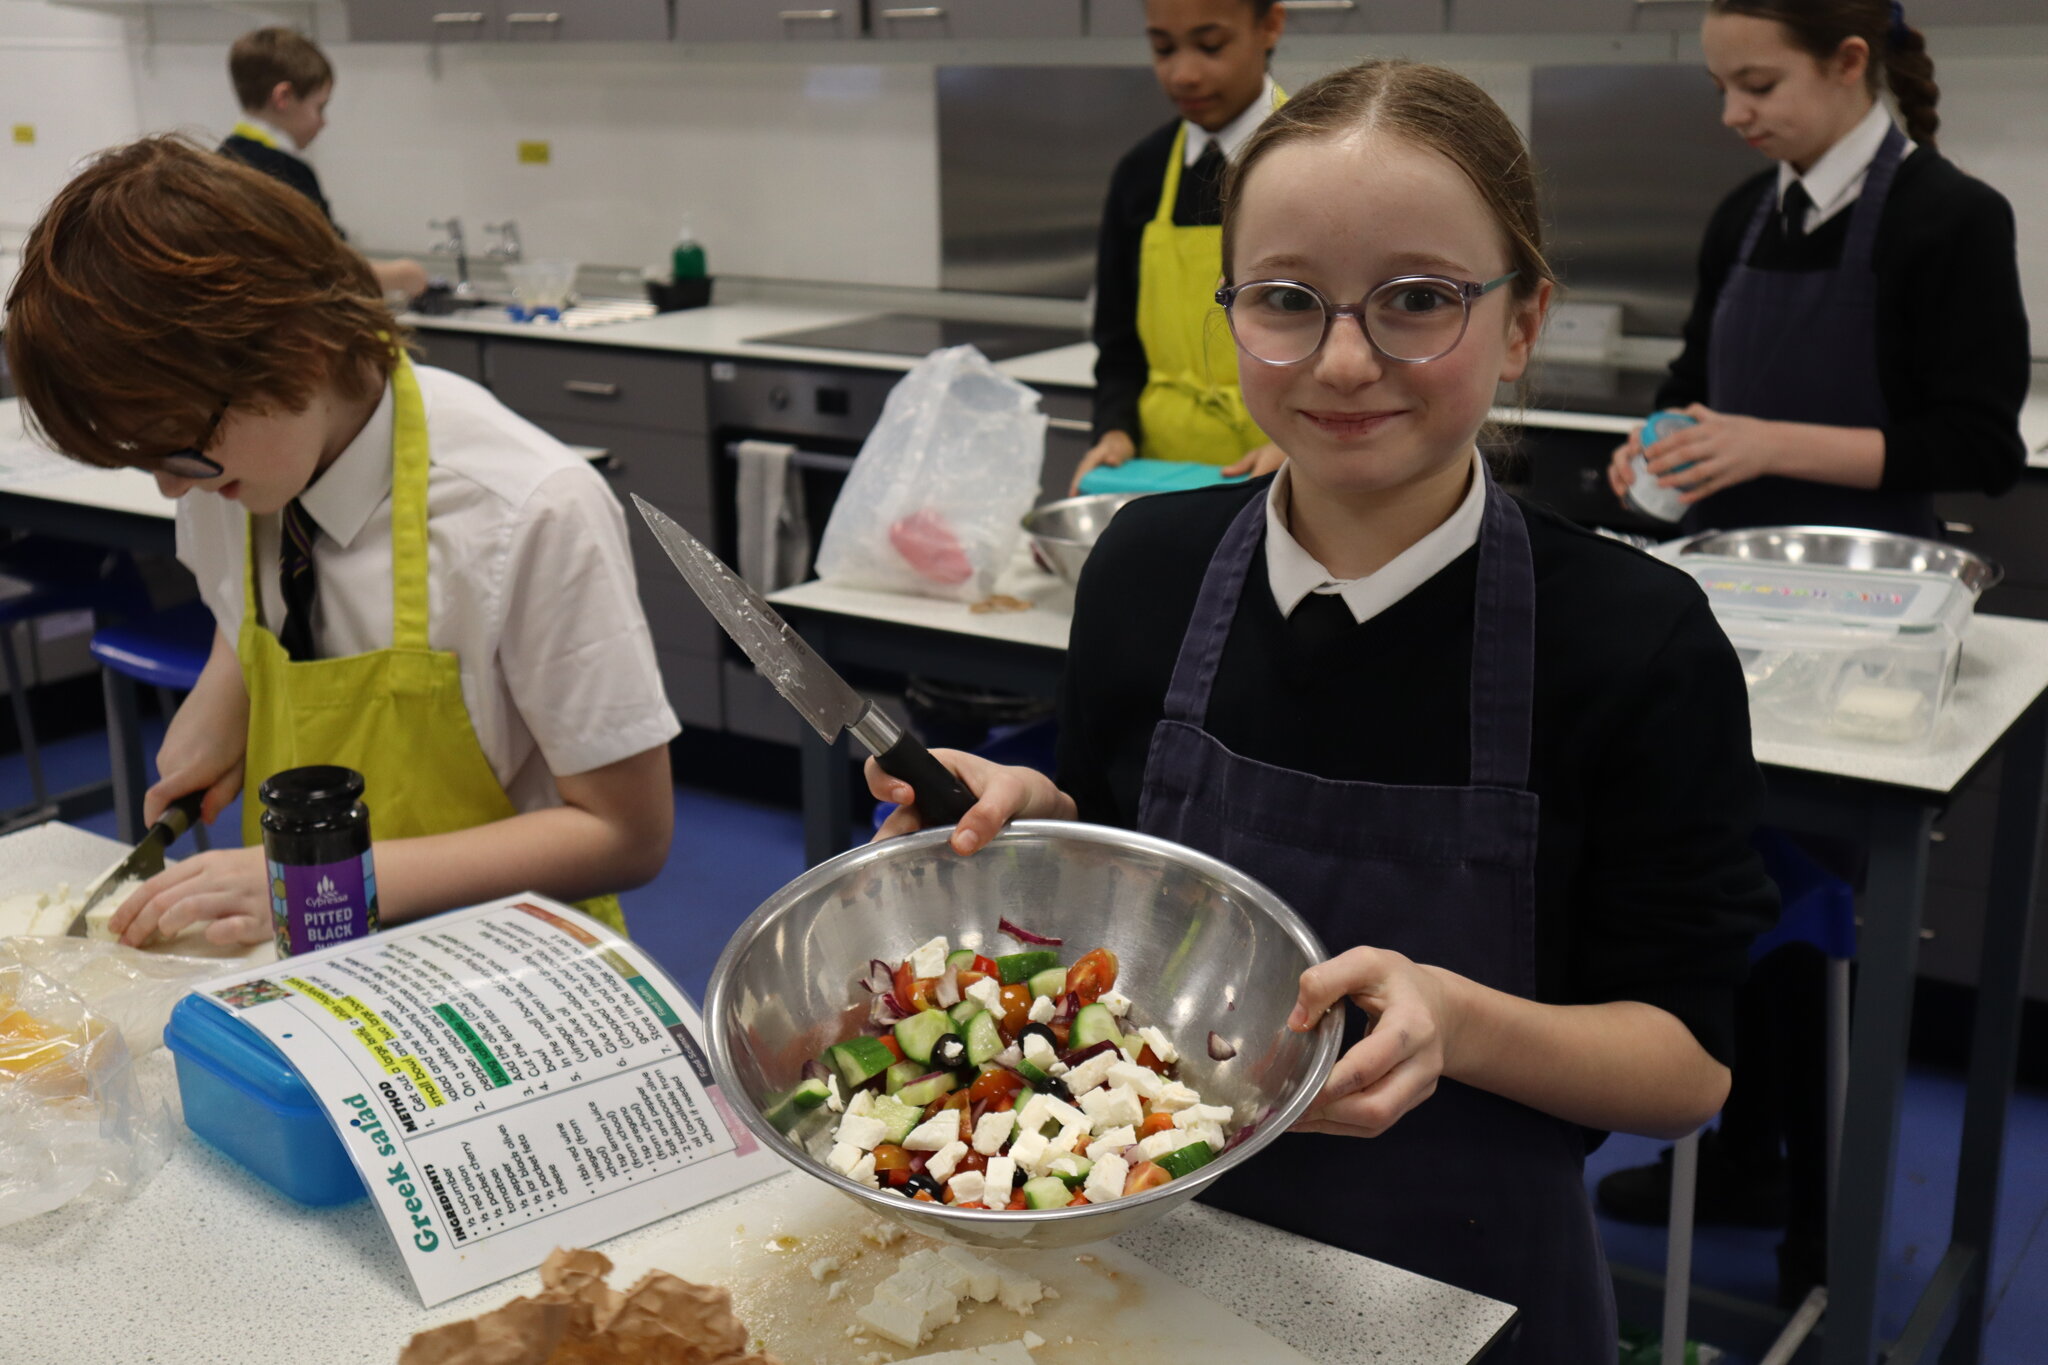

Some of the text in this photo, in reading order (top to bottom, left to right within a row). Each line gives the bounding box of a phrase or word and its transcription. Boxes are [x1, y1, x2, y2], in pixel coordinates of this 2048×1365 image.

[304, 907, 353, 926] PITTED
[307, 923, 353, 942] BLACK
[569, 946, 583, 955] ou
[495, 984, 515, 997] add
[545, 976, 566, 991] and
[580, 972, 601, 988] then
[598, 971, 623, 992] fridge
[397, 988, 432, 1015] tomatoes
[462, 991, 487, 1009] small
[559, 990, 585, 1011] salad
[587, 998, 600, 1007] or
[595, 988, 616, 1004] and
[619, 992, 636, 1007] the
[359, 1010, 382, 1027] large
[425, 1014, 445, 1029] and
[482, 1009, 501, 1024] into
[530, 998, 557, 1023] lemon
[581, 1012, 604, 1031] your
[612, 1004, 630, 1020] mix
[632, 1006, 644, 1016] in
[376, 1026, 395, 1041] two
[404, 1012, 441, 1046] chopping
[453, 1021, 476, 1042] knife
[474, 1021, 498, 1044] olives
[495, 1024, 515, 1042] feta
[527, 1017, 552, 1040] small
[555, 1006, 603, 1058] and olive oil
[594, 1007, 635, 1049] (chopped
[623, 1020, 650, 1045] good
[639, 1016, 663, 1041] Store
[387, 1040, 409, 1057] and
[440, 1028, 467, 1054] onions
[470, 1041, 491, 1060] safe
[492, 1044, 510, 1060] the
[510, 1042, 528, 1058] the
[547, 1040, 565, 1057] the
[597, 1031, 618, 1054] Give
[372, 1044, 396, 1067] large
[380, 1009, 461, 1102] salad and one for waste
[435, 1046, 459, 1071] white
[532, 1048, 557, 1073] bowl
[559, 1057, 573, 1068] In
[401, 1057, 426, 1081] bowl
[463, 1055, 496, 1092] pepper,
[485, 1059, 510, 1087] Using
[502, 1060, 526, 1081] Add
[522, 1058, 541, 1077] Cut
[692, 1058, 708, 1077] Food
[395, 1074, 414, 1092] out
[460, 1080, 476, 1097] On
[641, 1071, 658, 1092] olive
[670, 1075, 695, 1108] needed
[407, 1092, 426, 1113] Get
[418, 1080, 444, 1107] small
[378, 1081, 418, 1133] METHOD
[587, 1100, 605, 1122] juice
[653, 1068, 703, 1148] oil (available from
[654, 1092, 687, 1145] tablespoons
[619, 1106, 644, 1144] oregano
[629, 1102, 668, 1160] (from school)
[636, 1086, 679, 1156] Salt and pepper
[693, 1116, 715, 1144] school
[496, 1124, 515, 1150] olives
[516, 1133, 532, 1154] feta
[555, 1122, 572, 1145] wine
[599, 1122, 620, 1153] lemon
[605, 1110, 644, 1169] (from school)
[460, 1141, 481, 1171] cherry
[566, 1145, 581, 1162] red
[568, 1118, 606, 1182] vinegar (from
[595, 1145, 619, 1178] school)
[615, 1152, 628, 1168] tsp
[640, 1144, 653, 1159] tsp
[341, 1093, 440, 1252] Greek salad
[510, 1150, 529, 1178] black
[527, 1154, 551, 1188] packet
[576, 1163, 591, 1181] tbls
[457, 1164, 476, 1192] onion
[475, 1171, 500, 1206] packet
[501, 1162, 526, 1197] pepper
[524, 1179, 539, 1193] jar
[547, 1163, 568, 1195] cheese
[442, 1167, 471, 1216] cucumber
[469, 1193, 484, 1211] red
[489, 1167, 517, 1214] tomatoes
[423, 1164, 467, 1241] INGREDIENTS
